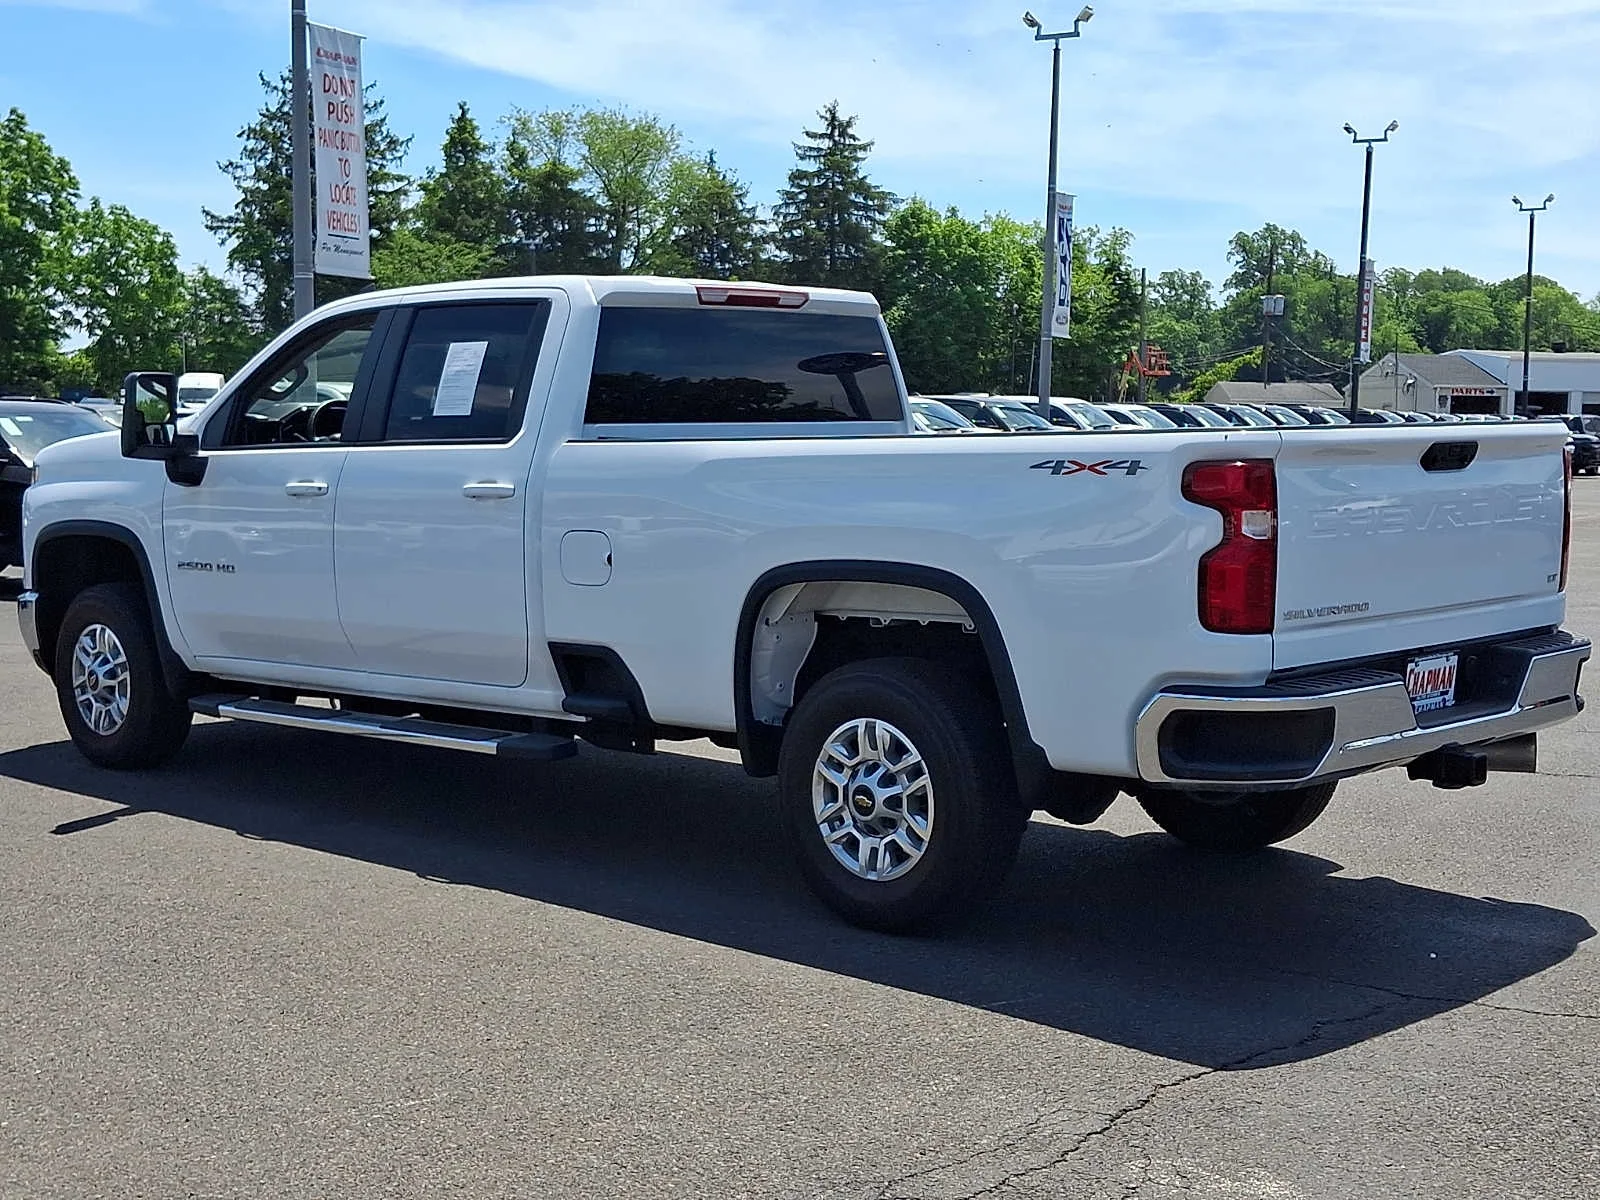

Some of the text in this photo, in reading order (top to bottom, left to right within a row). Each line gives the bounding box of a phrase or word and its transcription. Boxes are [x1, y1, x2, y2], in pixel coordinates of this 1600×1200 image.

[323, 73, 339, 95] DO
[328, 101, 355, 125] PUSH
[318, 127, 339, 150] PANIC
[338, 157, 351, 178] TO
[329, 183, 357, 207] LOCATE
[1451, 387, 1486, 395] PARTS
[177, 561, 236, 573] 2500 HD
[1408, 664, 1455, 695] CHAPMAN
